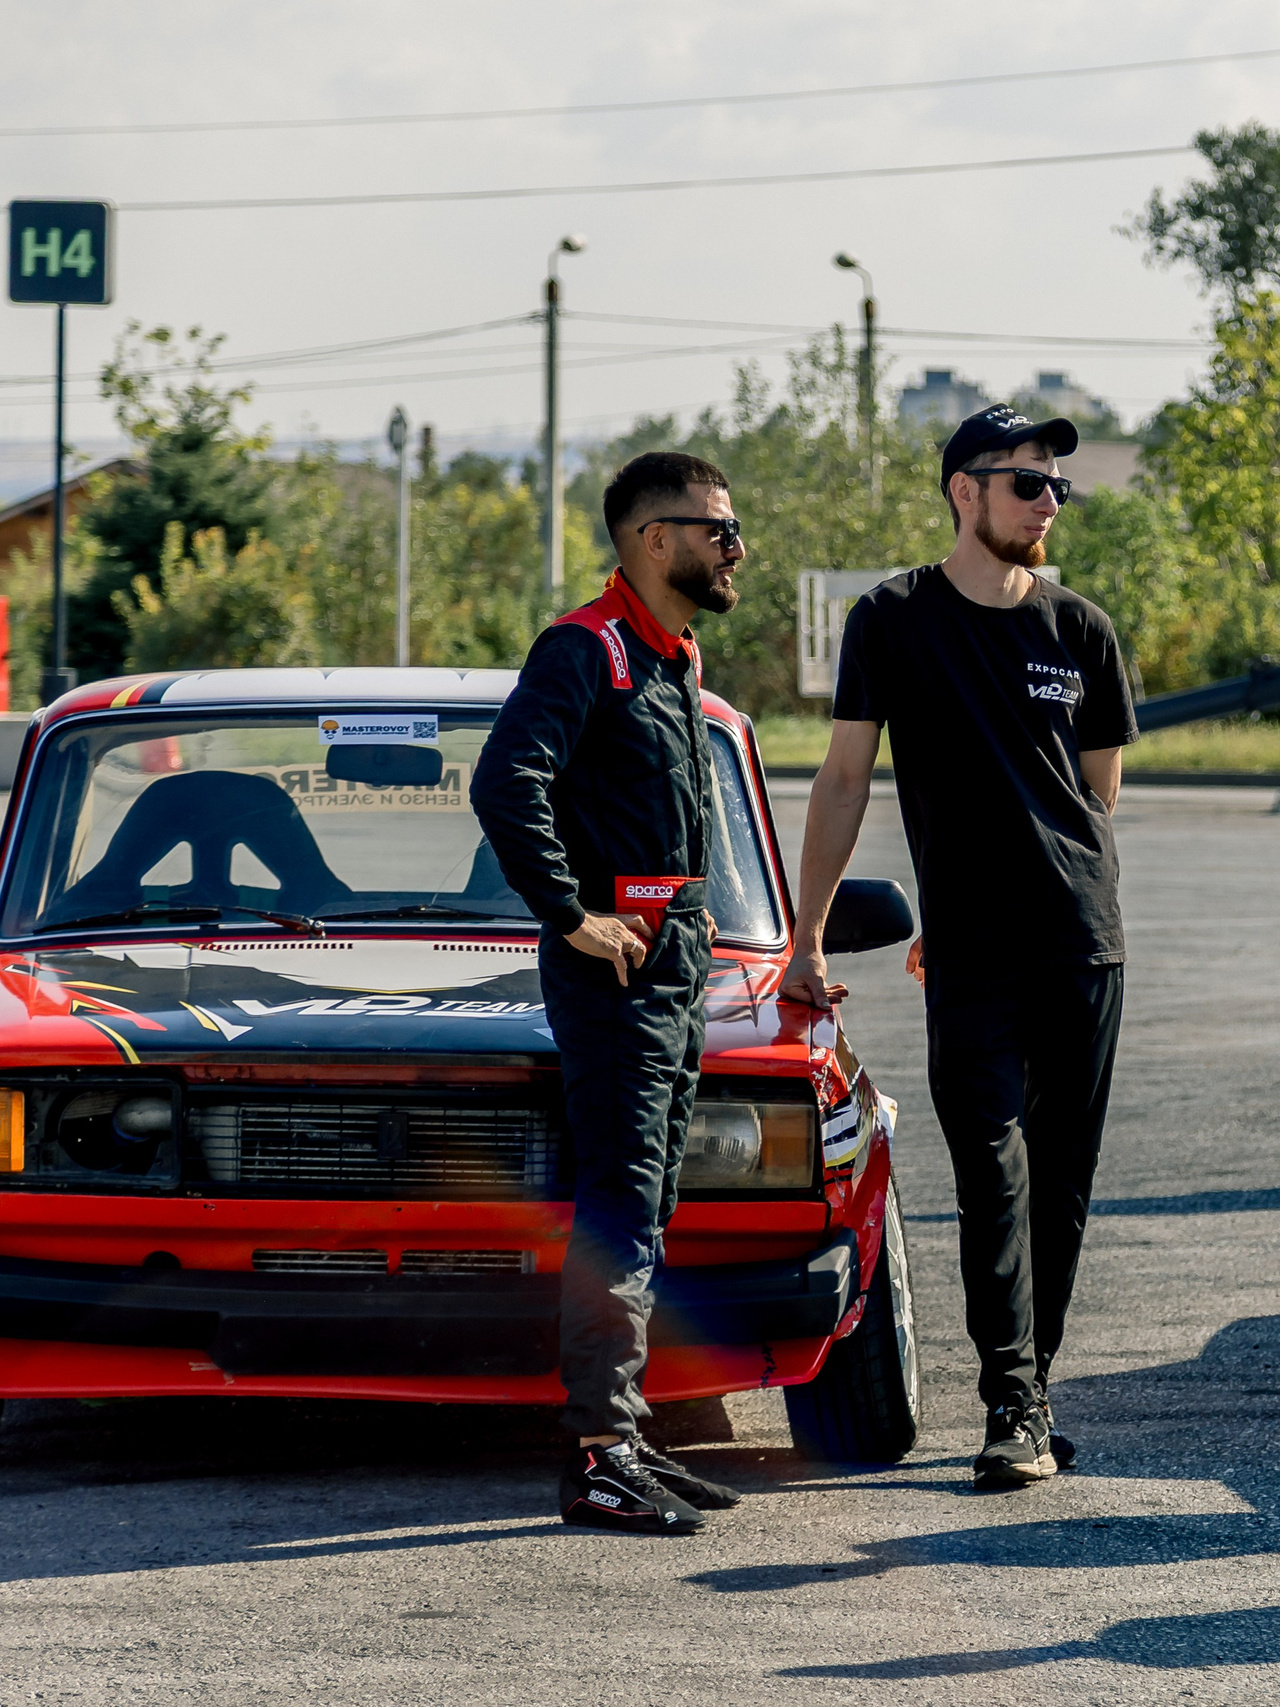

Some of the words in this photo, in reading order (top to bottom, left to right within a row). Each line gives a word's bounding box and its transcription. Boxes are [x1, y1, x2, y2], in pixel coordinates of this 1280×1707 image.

[21, 227, 96, 278] H4
[598, 629, 627, 681] sparco
[1027, 662, 1080, 680] EXPOCAR
[1062, 688, 1080, 701] TEAM
[625, 885, 674, 898] sparco
[433, 1000, 546, 1013] TEAM
[588, 1489, 621, 1508] sparco
